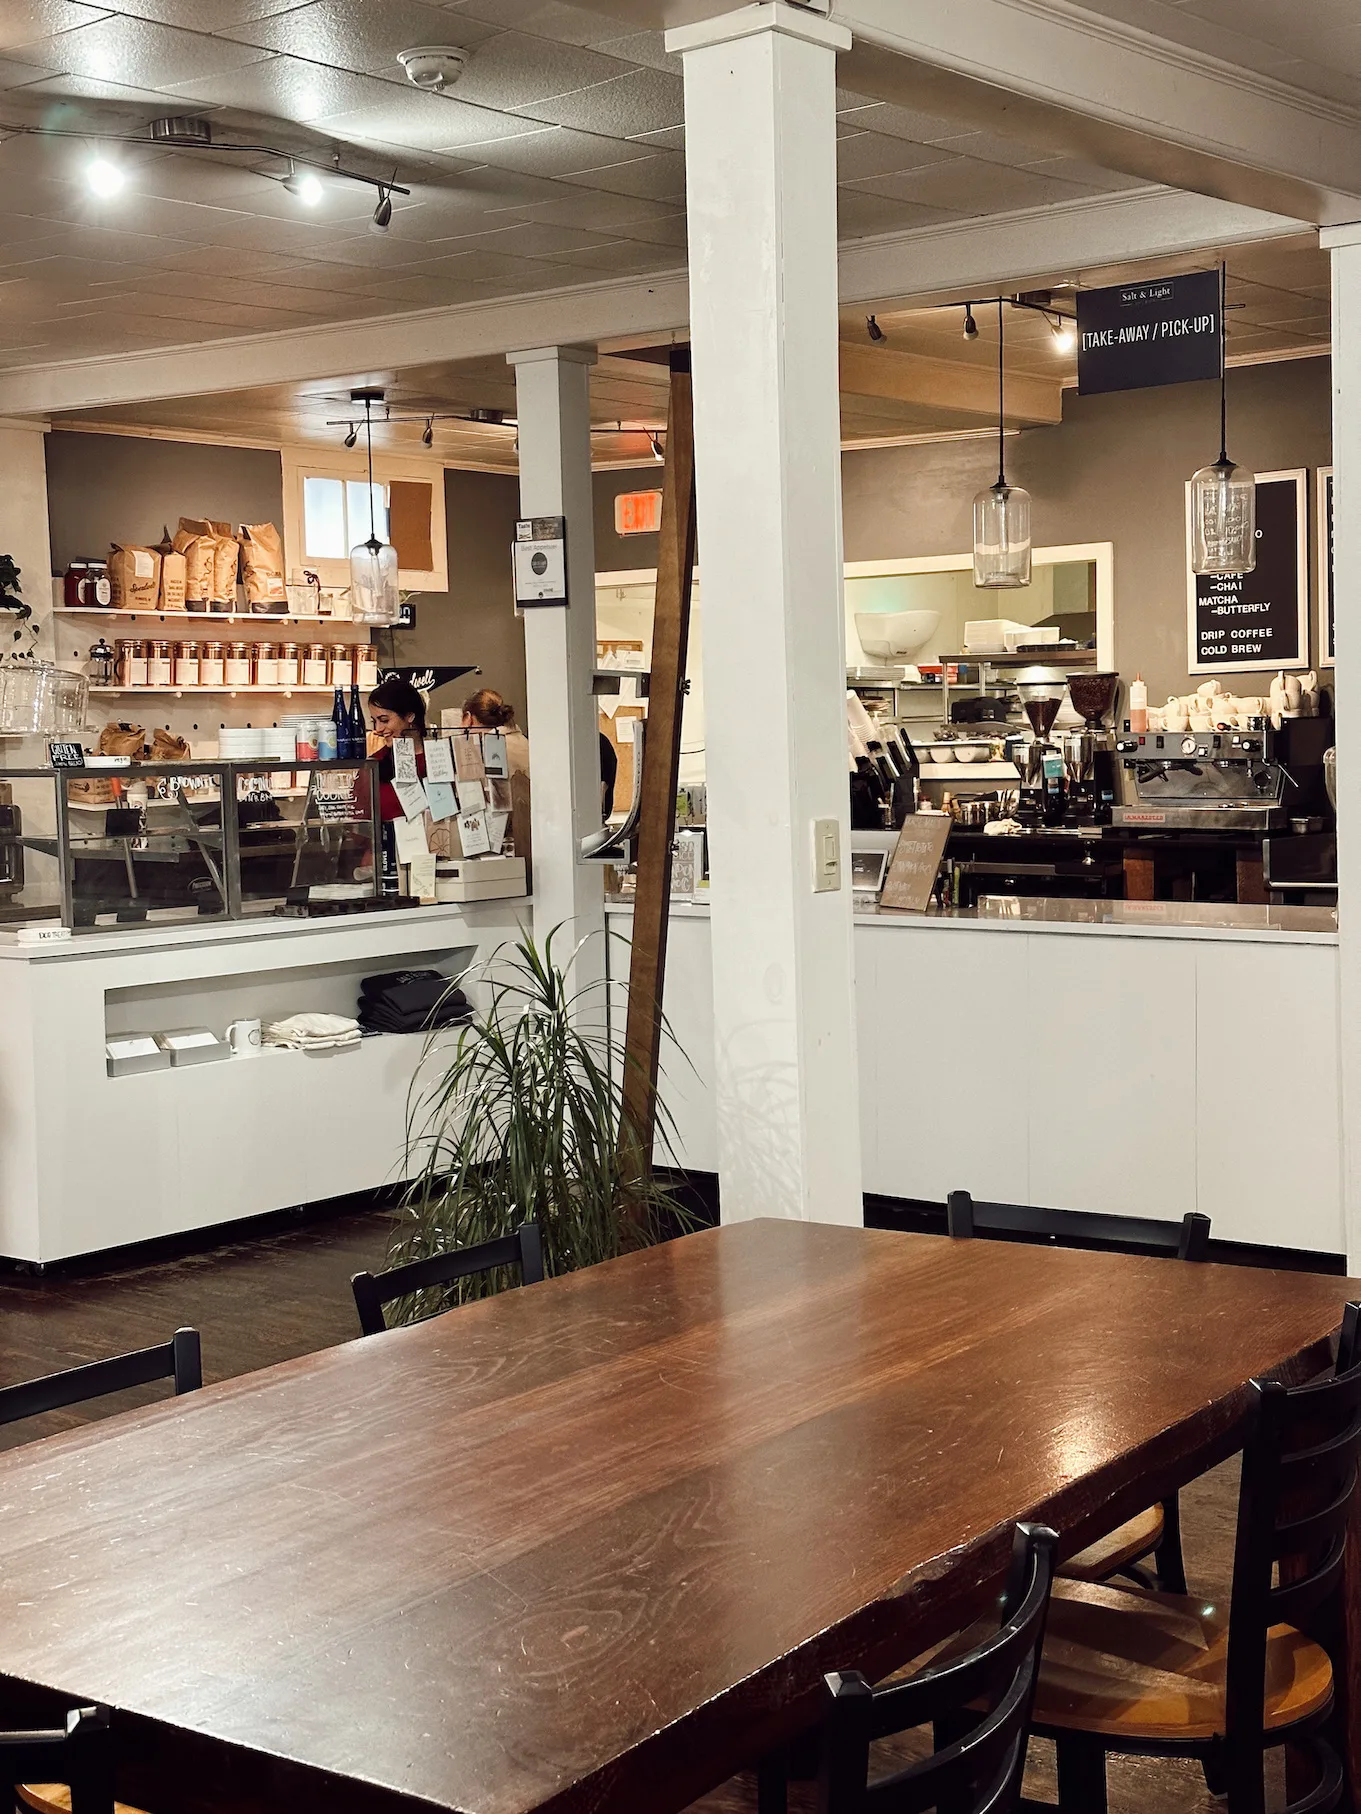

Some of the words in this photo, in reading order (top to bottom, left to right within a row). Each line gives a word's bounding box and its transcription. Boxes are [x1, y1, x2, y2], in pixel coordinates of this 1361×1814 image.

[1122, 291, 1137, 301] Salt
[1139, 290, 1147, 299] &
[1149, 287, 1171, 298] Light
[1082, 324, 1150, 352] [TAKE-AWAY
[1152, 322, 1159, 341] /
[1161, 314, 1215, 338] PICK-UP]
[1210, 581, 1243, 591] -CHAI
[1198, 595, 1239, 607] MATCHA
[1210, 602, 1271, 615] -BUTTERFLY
[1200, 630, 1226, 641] DRIP
[1230, 628, 1273, 639] COFFEE
[1200, 645, 1228, 656] COLD
[1231, 643, 1262, 654] BREW
